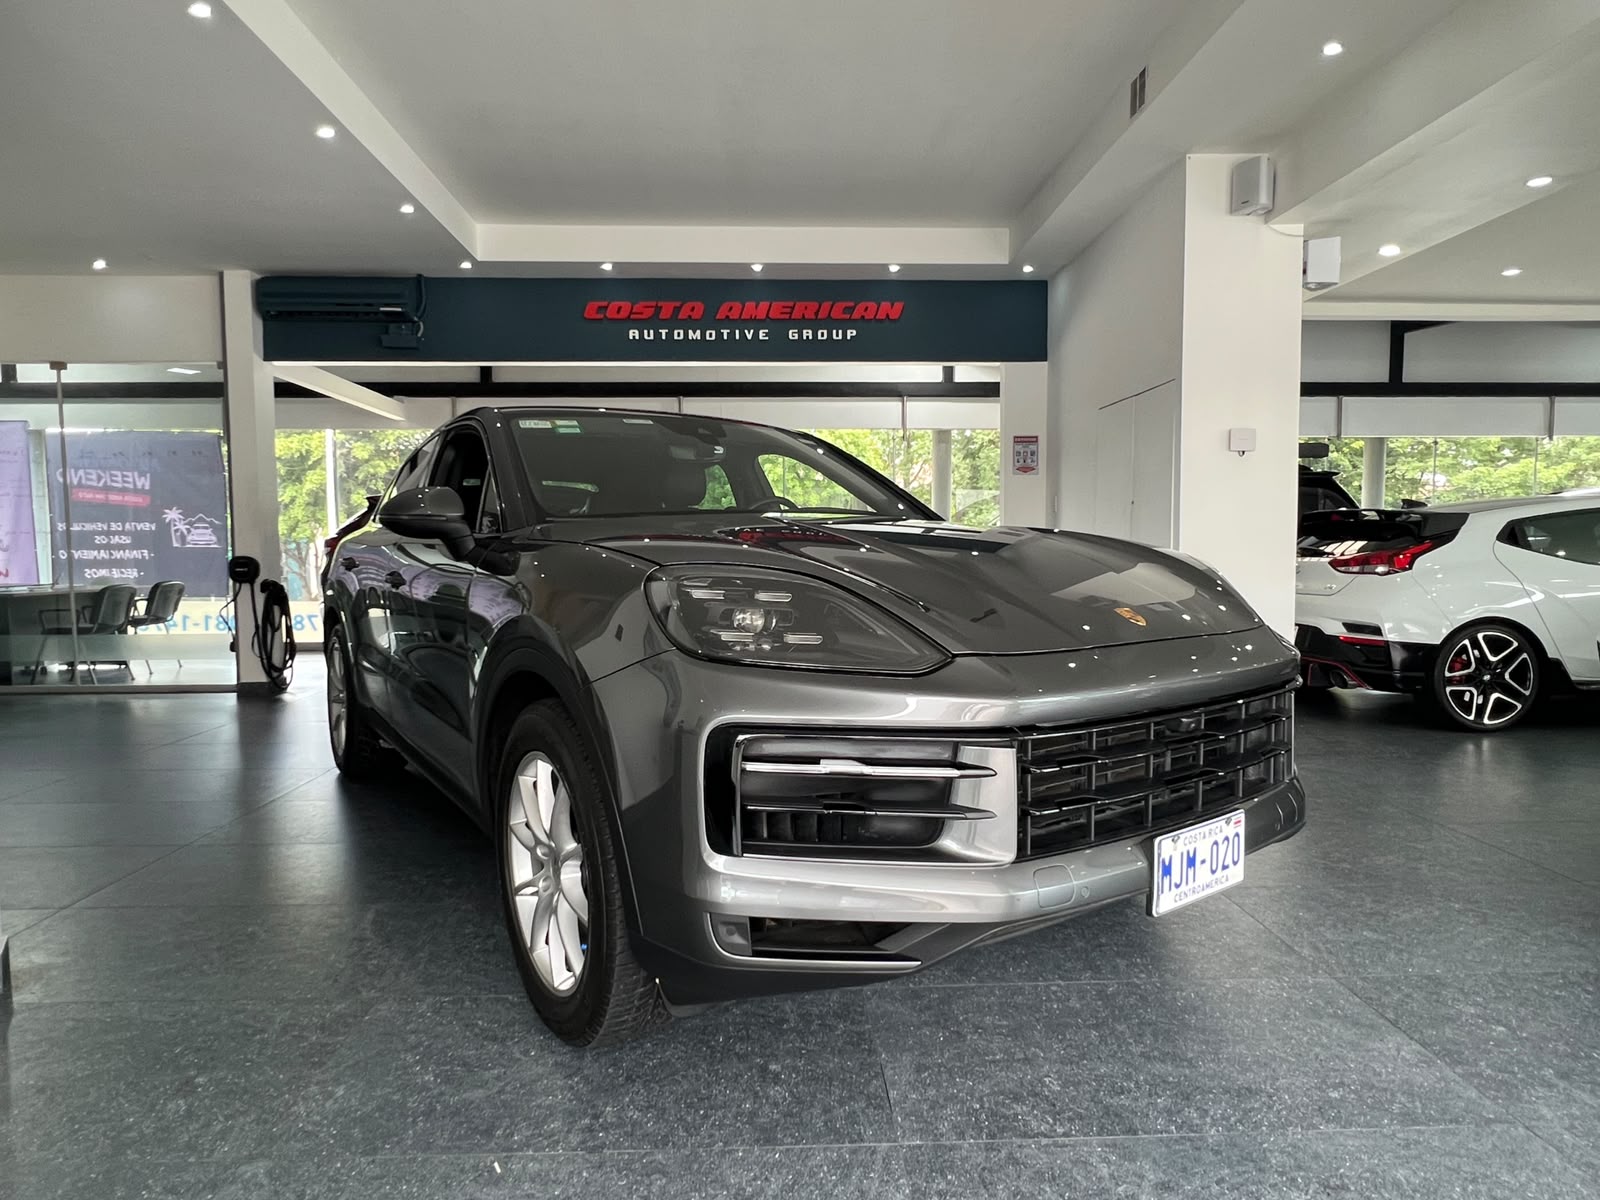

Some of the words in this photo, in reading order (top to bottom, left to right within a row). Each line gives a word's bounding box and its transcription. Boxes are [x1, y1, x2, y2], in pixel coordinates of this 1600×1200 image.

[584, 301, 704, 320] COSTA
[715, 301, 904, 320] AMERICAN
[628, 329, 769, 341] AUTOMOTIVE
[788, 329, 857, 341] GROUP
[1183, 831, 1207, 847] COSTA
[1160, 832, 1240, 894] MJM-020
[1173, 874, 1230, 903] CENTROAMERICA
